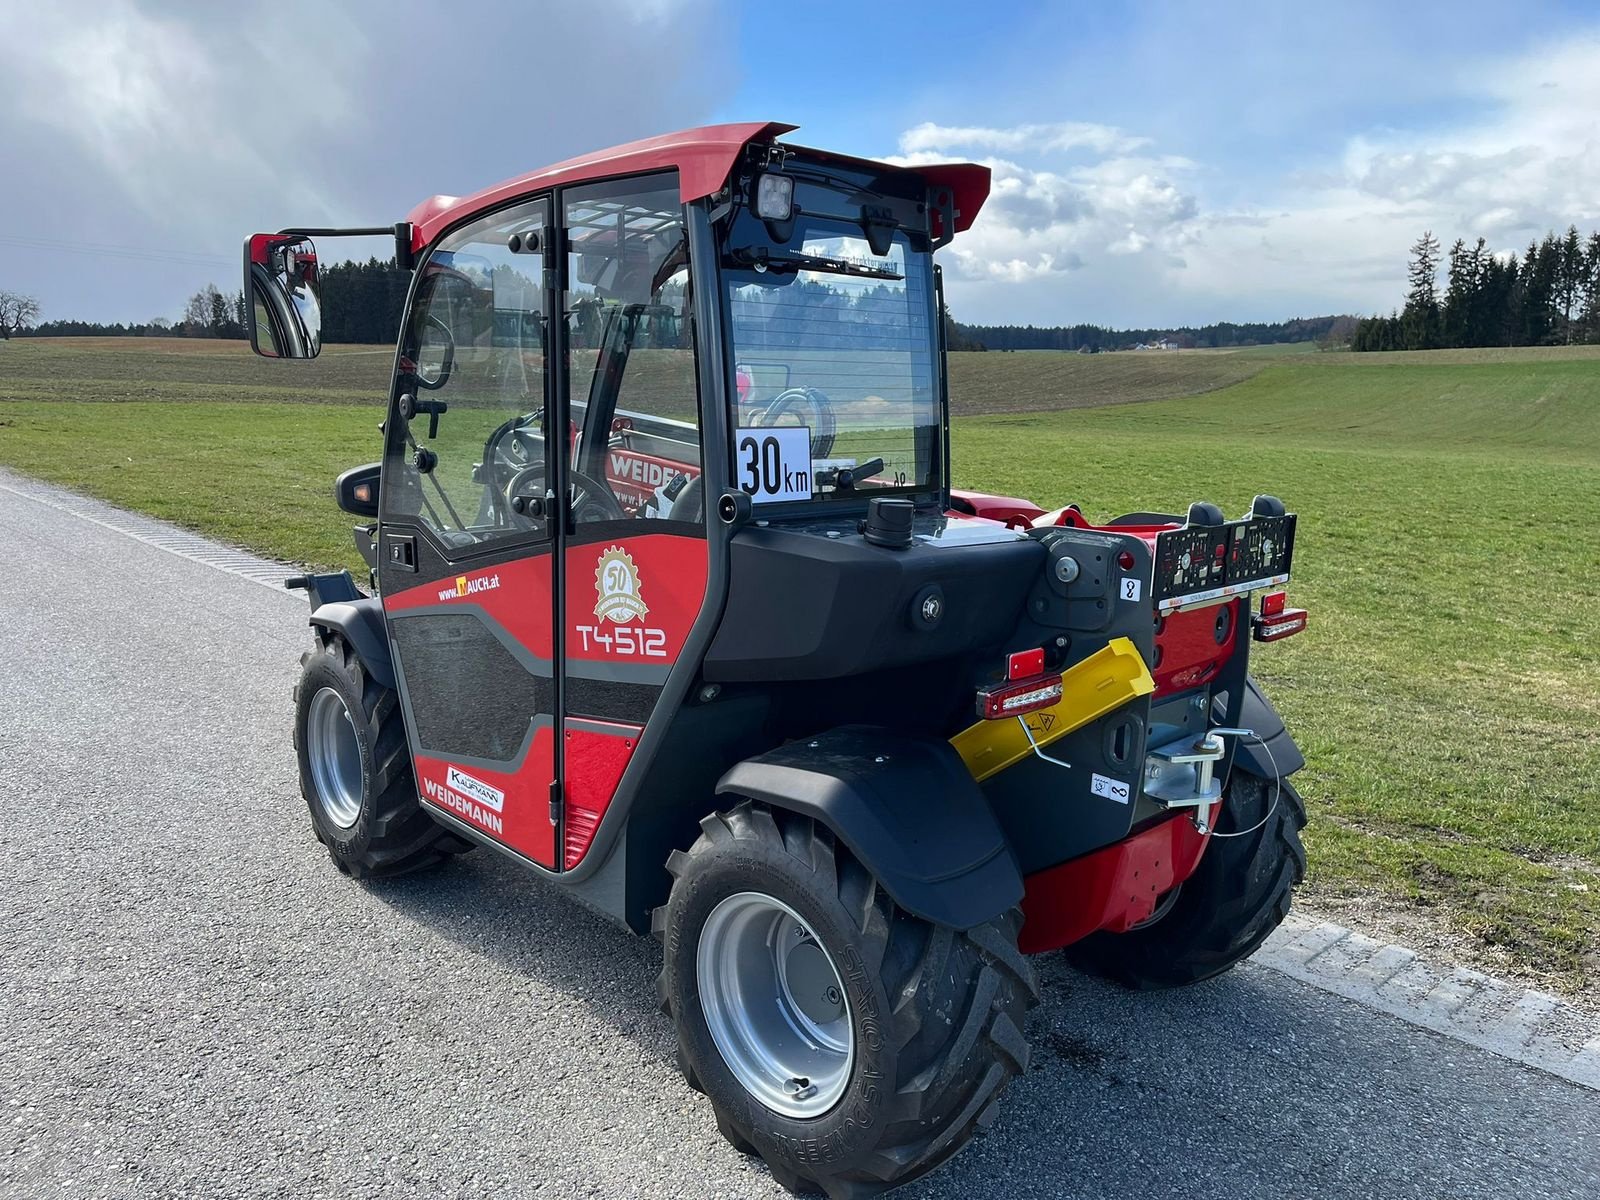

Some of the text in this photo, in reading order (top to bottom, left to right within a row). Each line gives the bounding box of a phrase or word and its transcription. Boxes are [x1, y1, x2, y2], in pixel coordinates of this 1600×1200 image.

[740, 435, 808, 496] 30 km
[438, 574, 500, 601] www.MAUCH.at
[608, 566, 626, 592] 50
[576, 625, 667, 657] T4512
[424, 777, 502, 834] WEIDEMANN
[451, 770, 498, 803] KAUFMANN
[840, 943, 885, 1053] STARCO
[861, 1053, 885, 1104] AS
